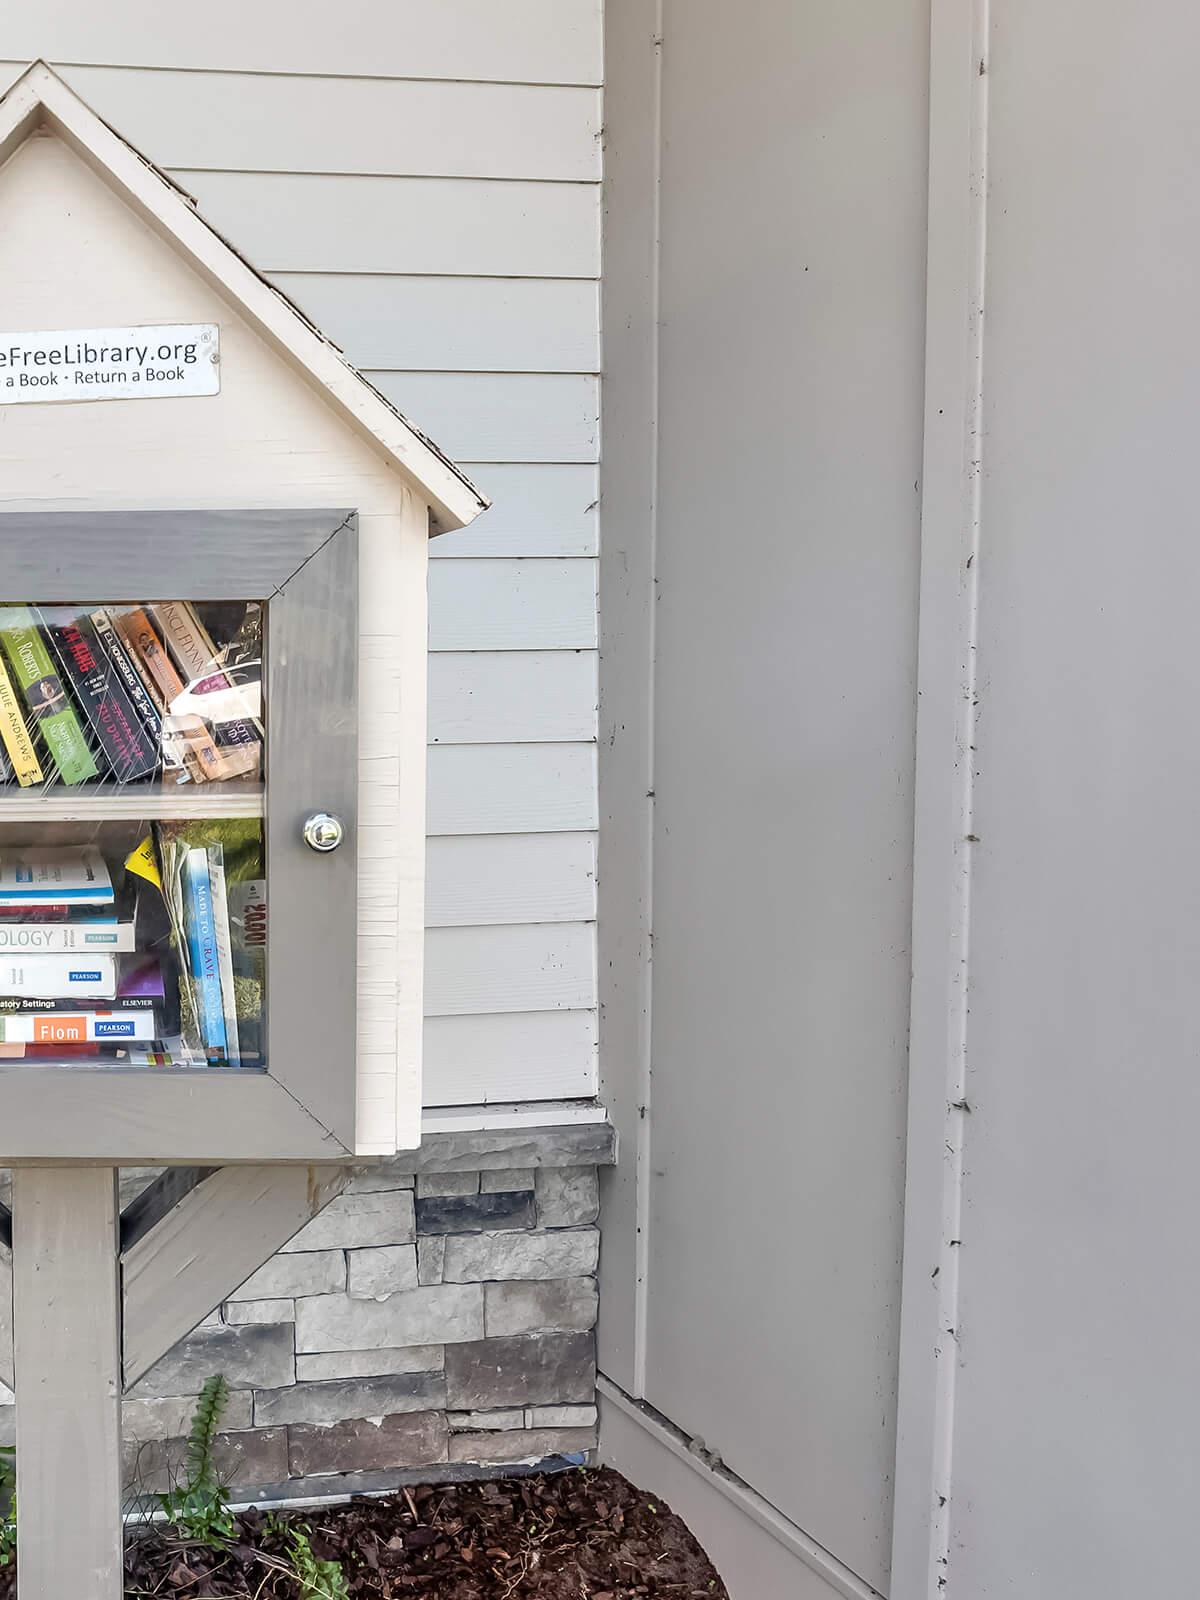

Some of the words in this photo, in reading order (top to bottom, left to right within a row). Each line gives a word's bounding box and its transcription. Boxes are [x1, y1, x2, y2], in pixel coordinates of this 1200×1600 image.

[6, 377, 14, 387] a
[20, 372, 58, 387] Book
[75, 370, 126, 384] Return
[132, 371, 140, 382] a
[146, 366, 185, 381] Book
[15, 641, 45, 680] ROBERTS
[7, 710, 32, 761] ANDREWS
[196, 885, 208, 915] MADE
[22, 1000, 56, 1009] Settings
[41, 1026, 79, 1040] Flom
[99, 1024, 131, 1032] PEARSON
